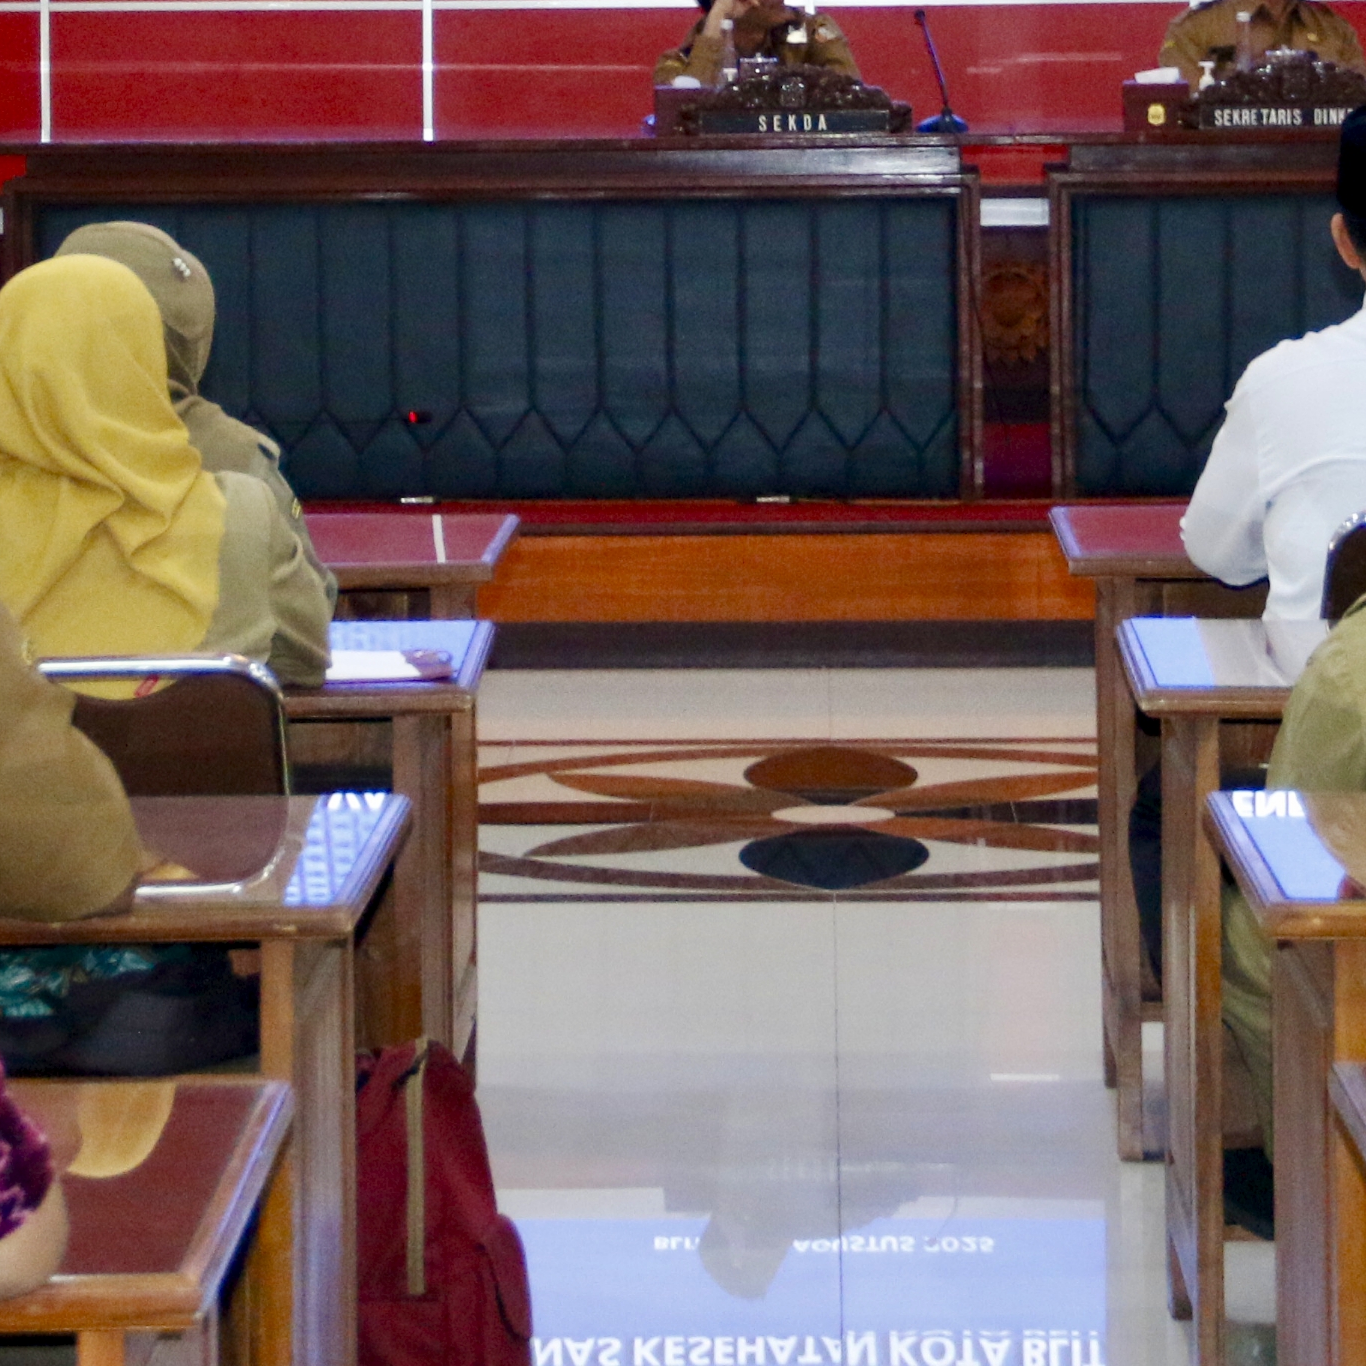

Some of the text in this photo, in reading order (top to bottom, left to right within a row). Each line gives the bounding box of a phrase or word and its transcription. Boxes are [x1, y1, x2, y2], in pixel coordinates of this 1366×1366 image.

[758, 113, 828, 132] SEKDA
[1214, 108, 1354, 127] SEKRETARIS DINK
